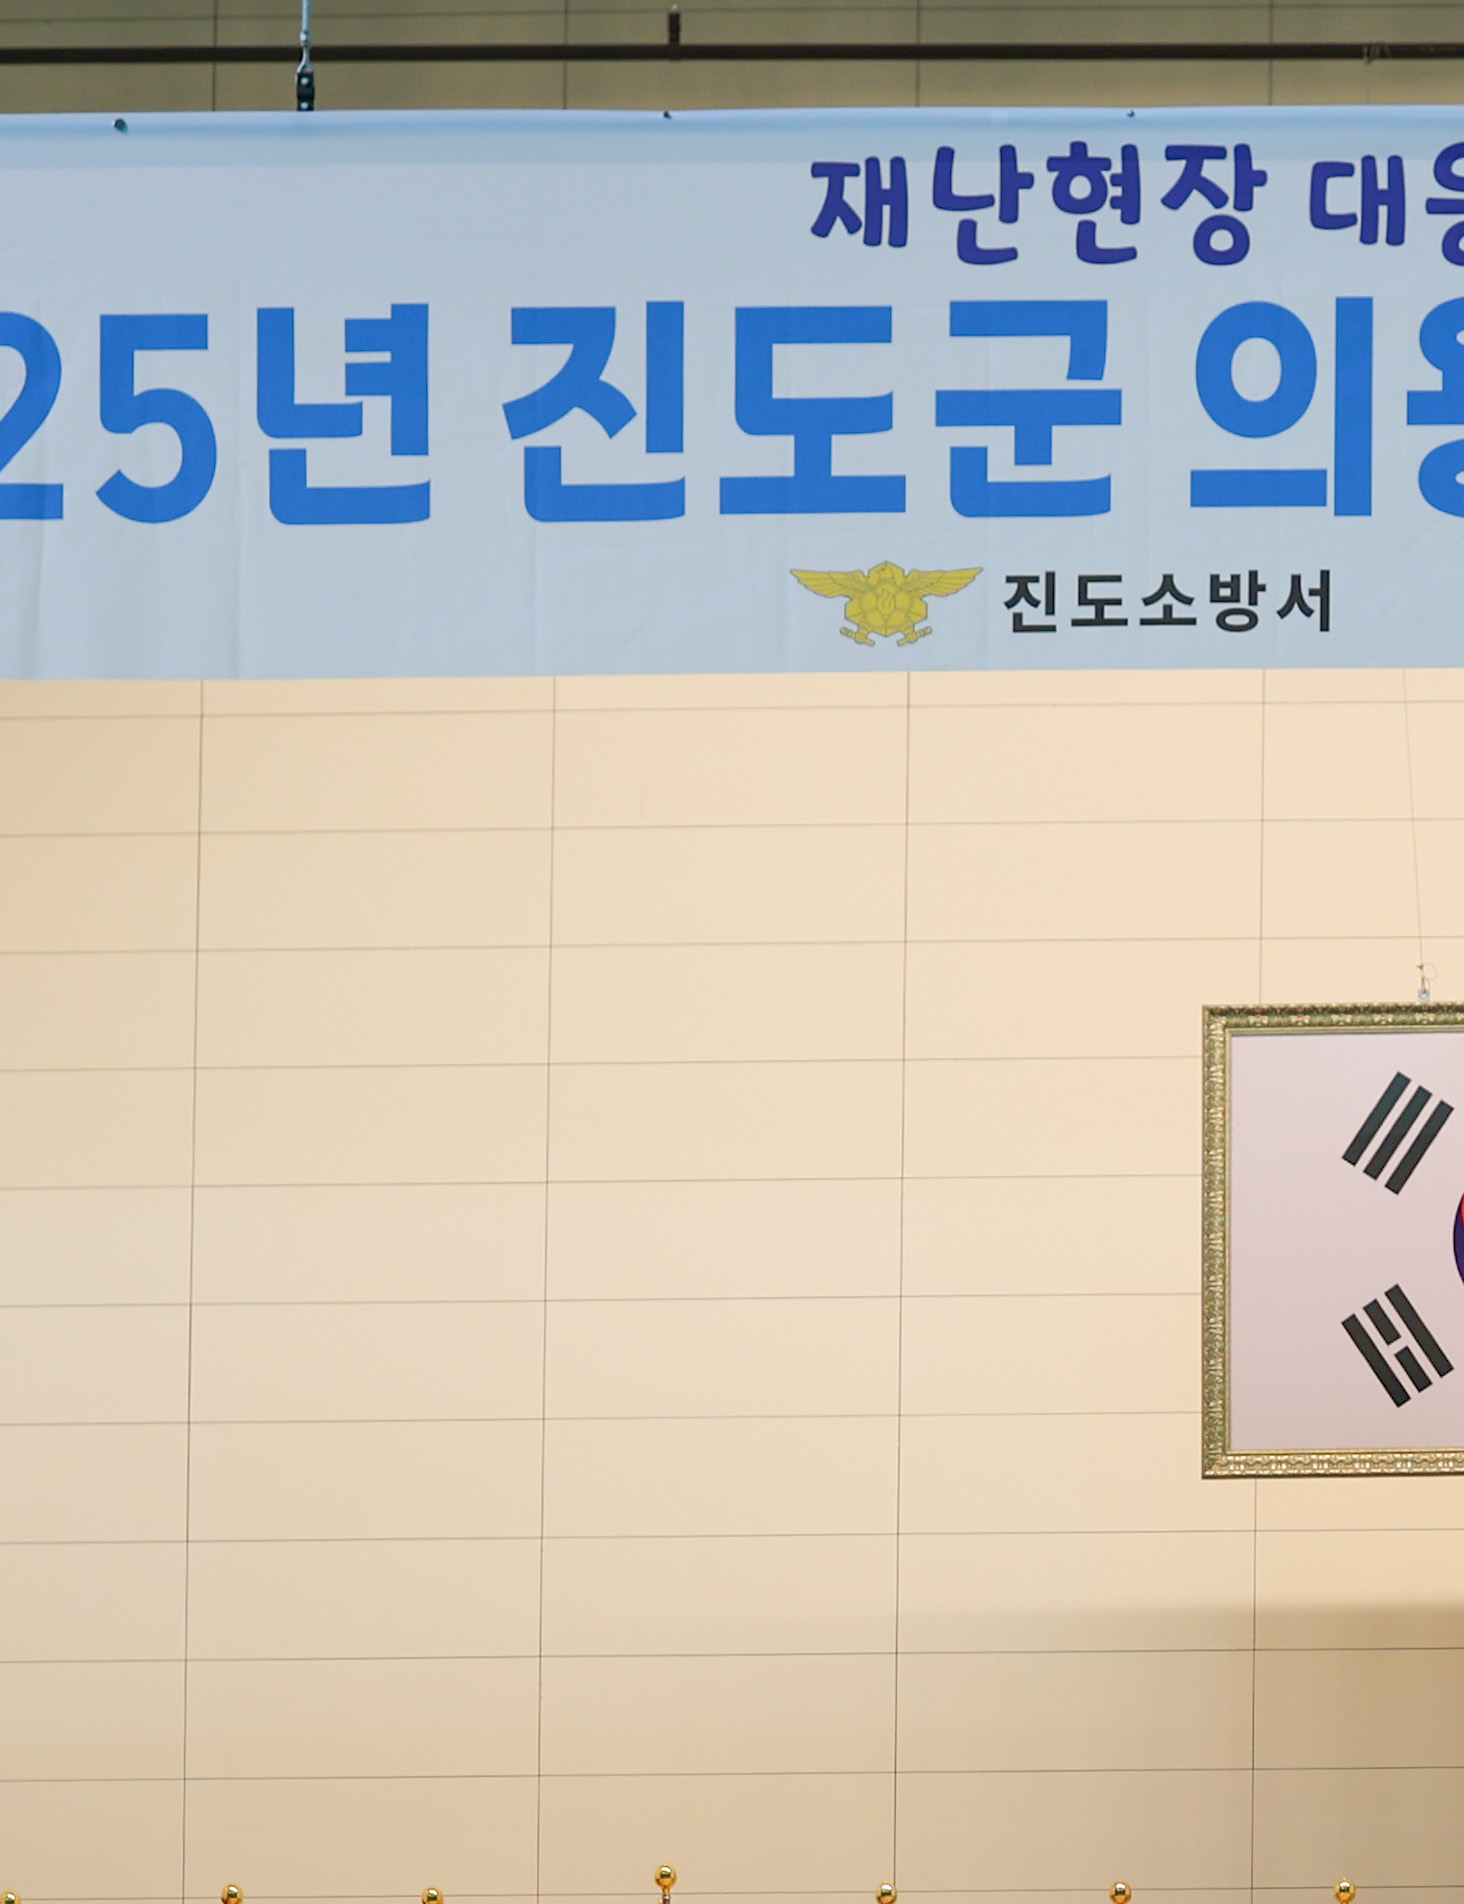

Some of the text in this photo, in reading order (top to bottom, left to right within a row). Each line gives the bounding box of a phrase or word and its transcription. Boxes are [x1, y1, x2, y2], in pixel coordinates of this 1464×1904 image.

[811, 142, 1267, 267] 재난현장
[503, 300, 1122, 524] 진도군
[1003, 569, 1332, 634] 진도소방서
